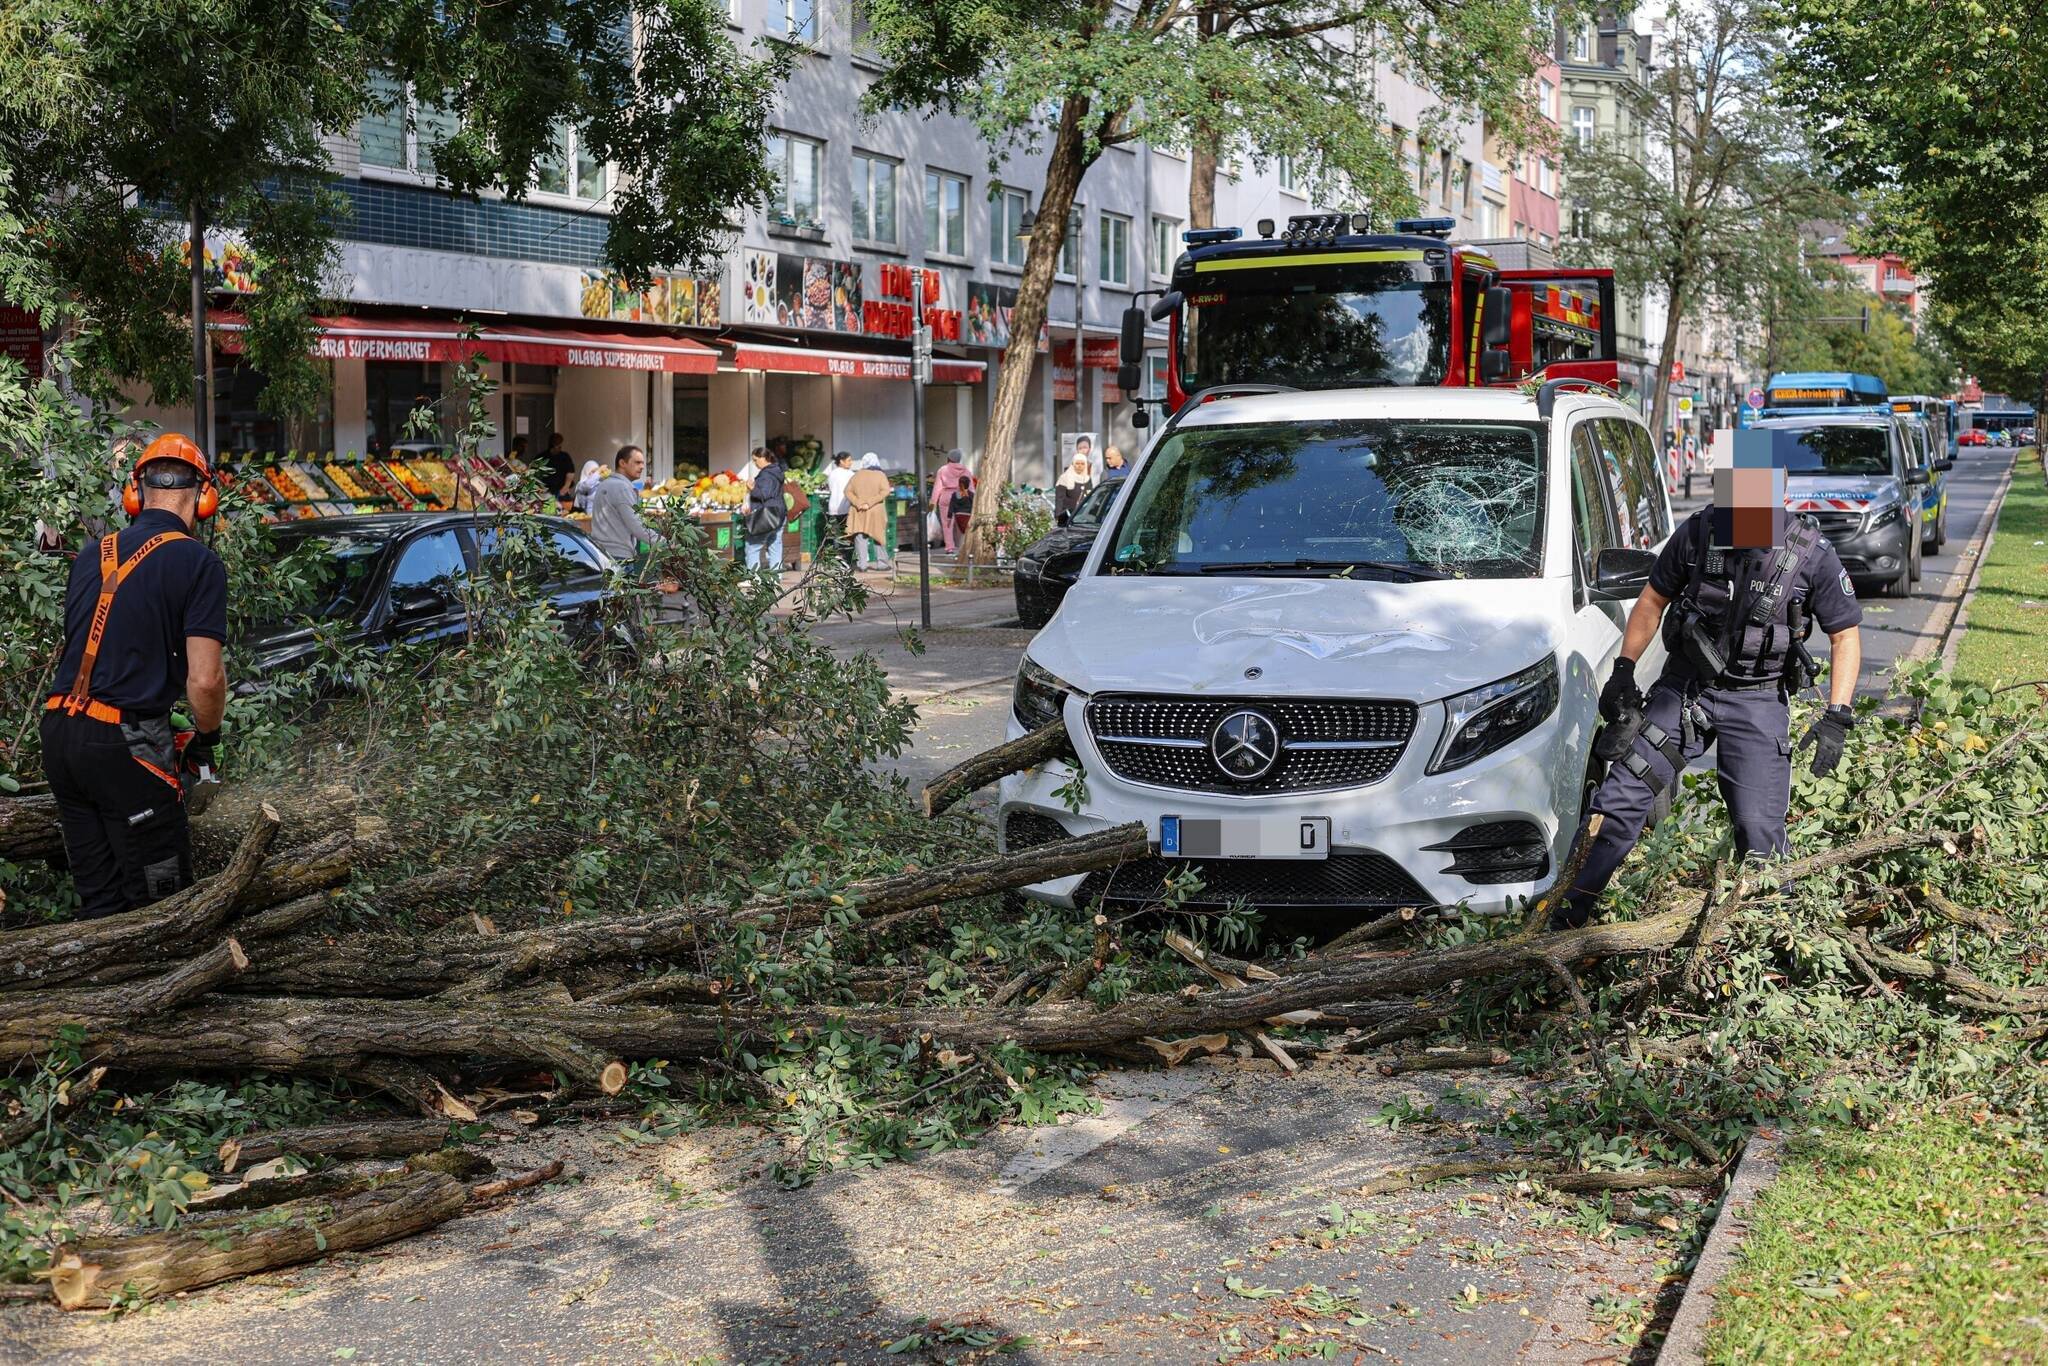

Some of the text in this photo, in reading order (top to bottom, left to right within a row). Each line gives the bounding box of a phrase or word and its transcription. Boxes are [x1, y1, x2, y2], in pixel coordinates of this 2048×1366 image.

[880, 264, 940, 305] DILRA
[1191, 294, 1223, 303] 1-RW-01
[348, 339, 431, 360] SUPERMARKET
[568, 349, 665, 370] DILARA SUPERMARKET
[828, 359, 910, 377] DILARA SUPERMARKET
[104, 537, 114, 562] STIHL
[130, 536, 163, 565] STIHL
[91, 600, 110, 644] STIHL
